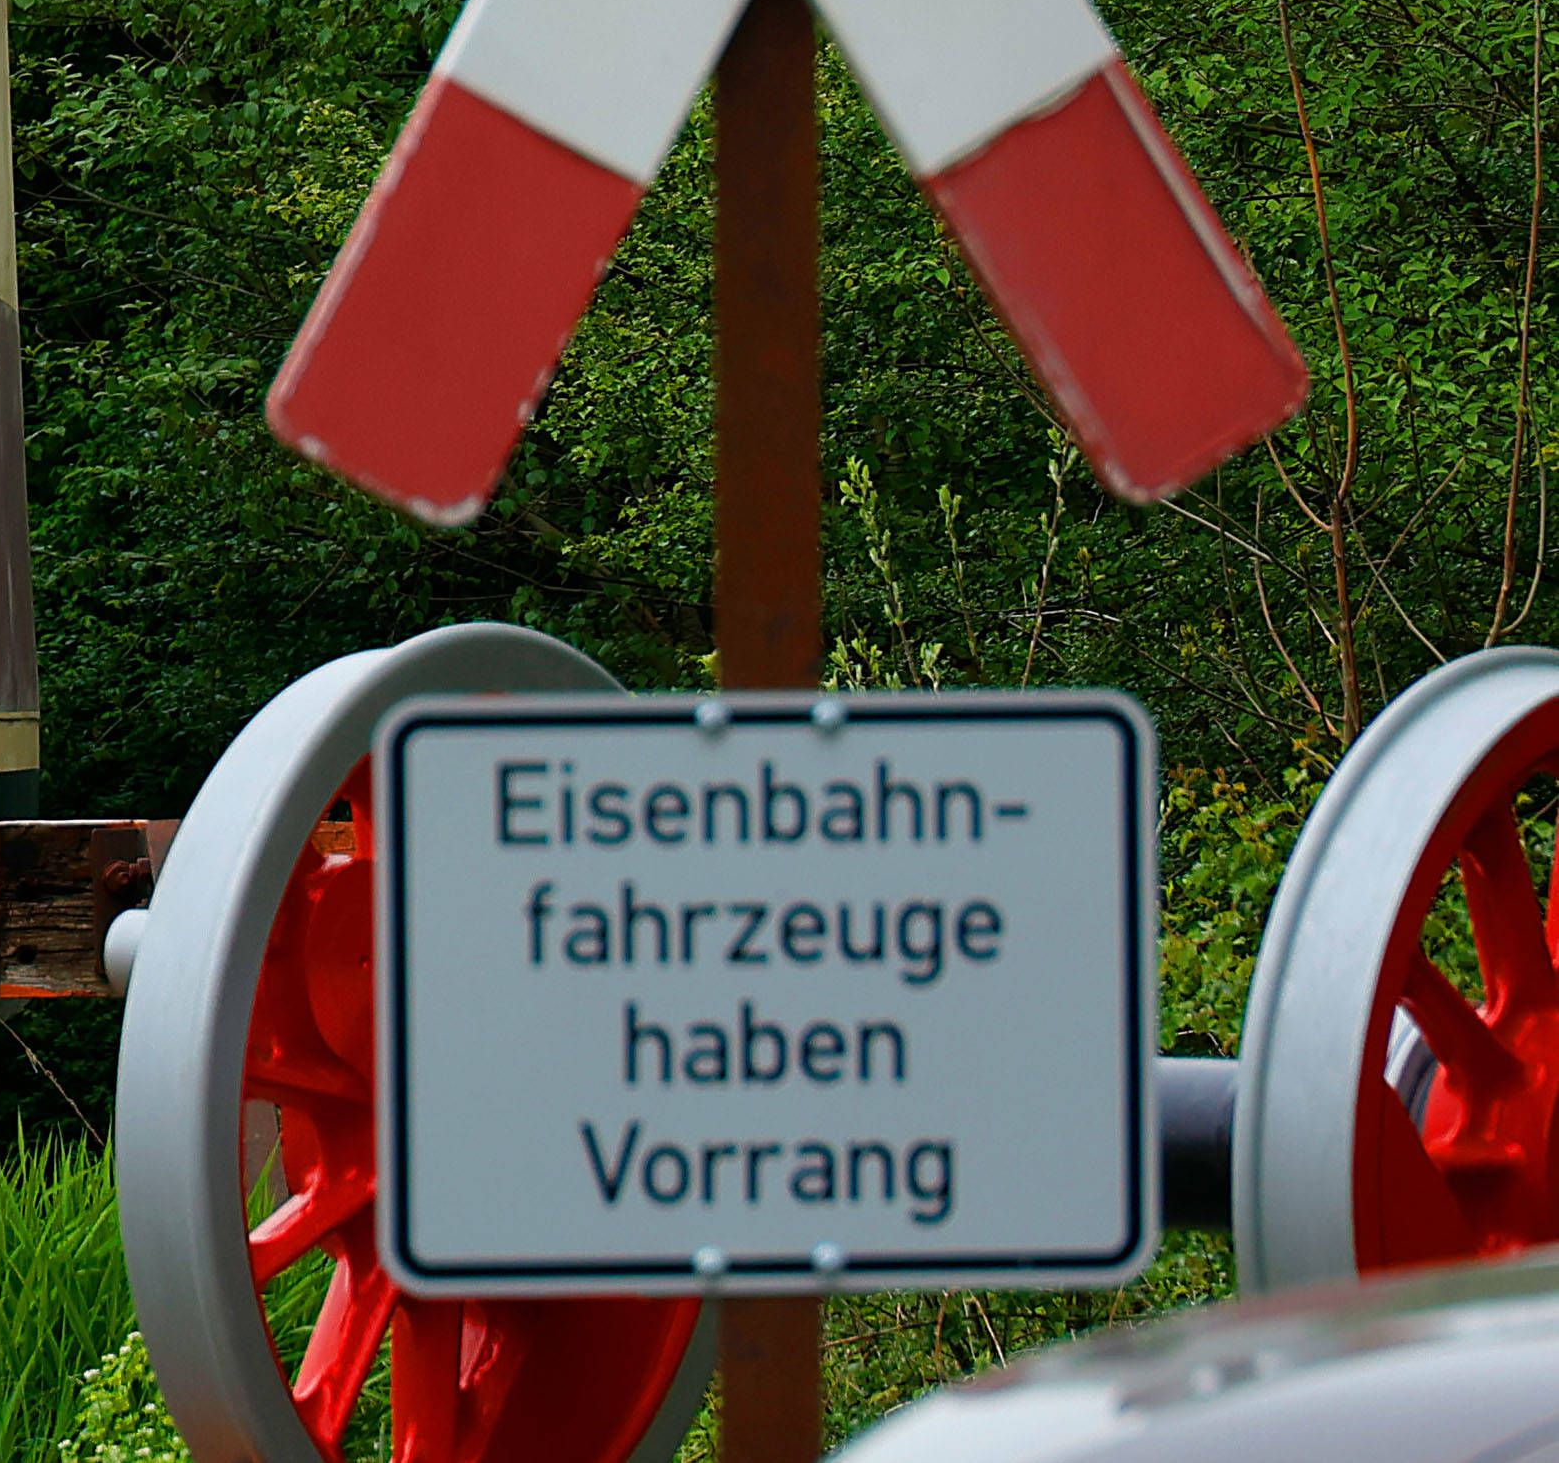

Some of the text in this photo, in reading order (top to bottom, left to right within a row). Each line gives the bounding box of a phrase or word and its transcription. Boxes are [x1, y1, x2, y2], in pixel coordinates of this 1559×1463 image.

[494, 759, 1031, 848] Eisenbahn-
[525, 881, 1006, 987] fahrzeuge
[623, 998, 908, 1087] haben
[579, 1119, 956, 1227] Vorrang
